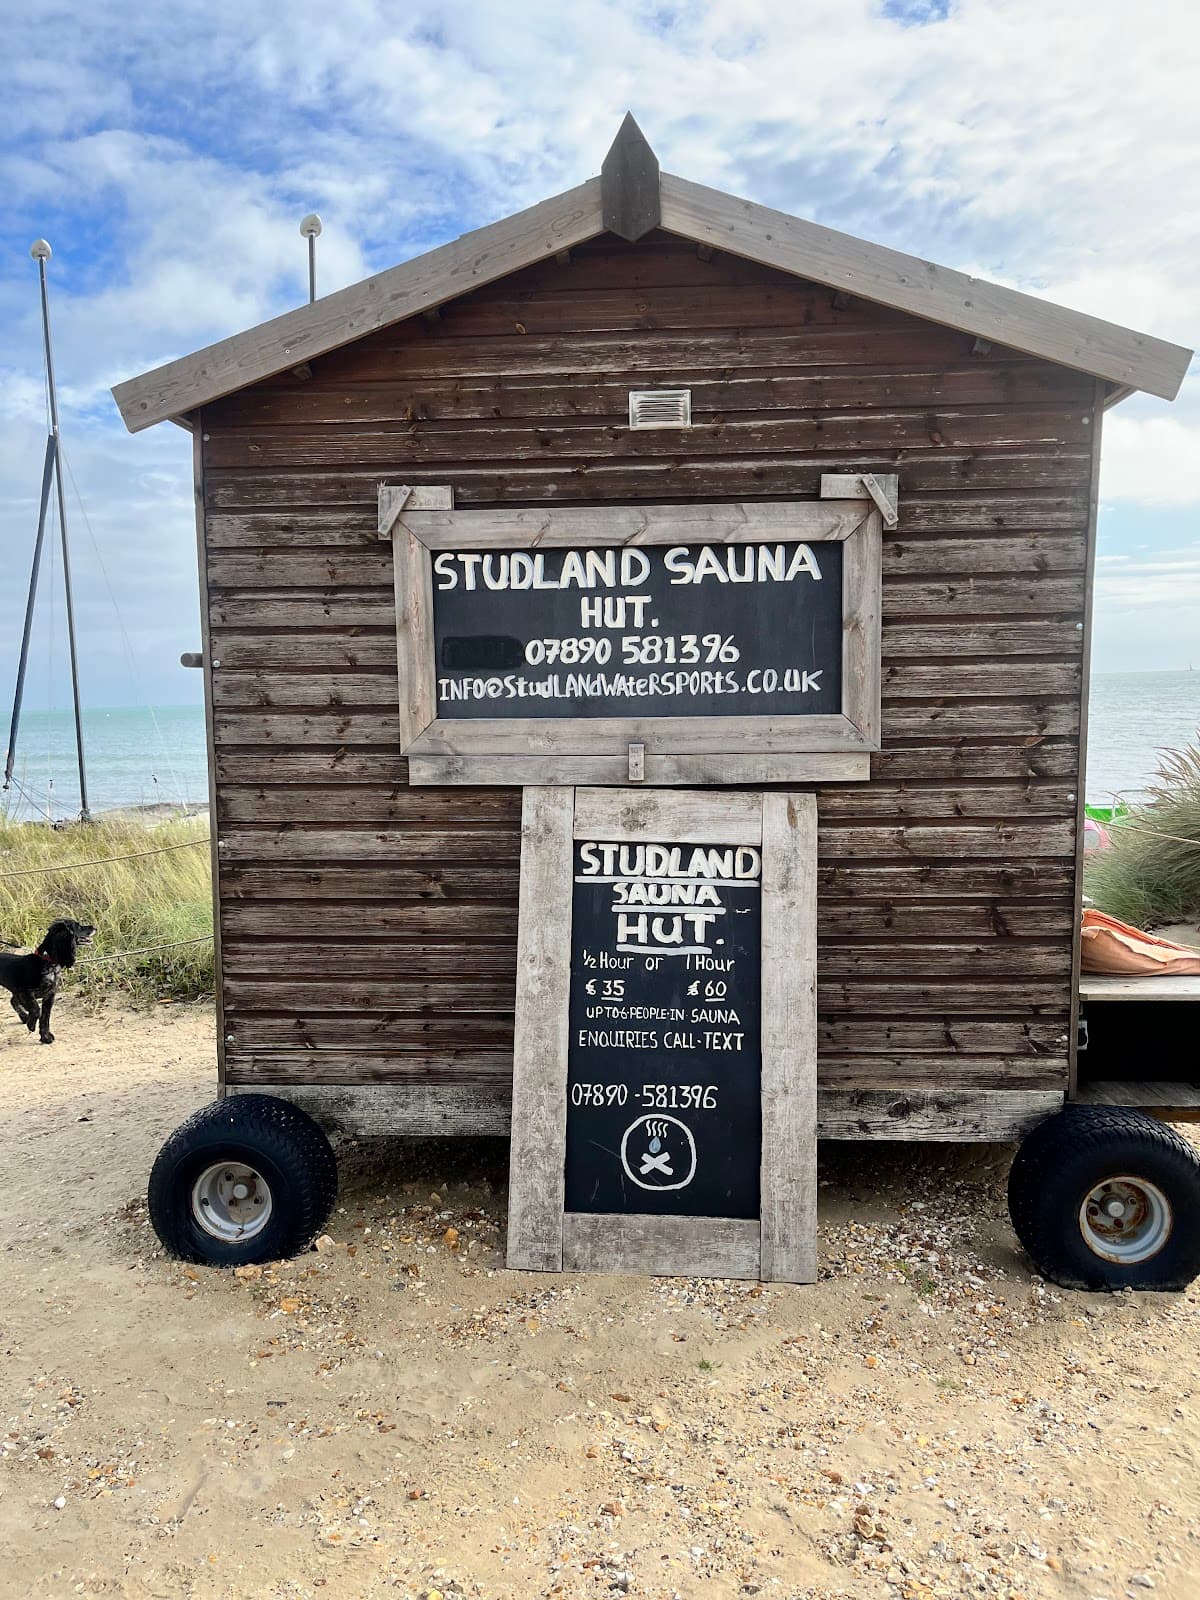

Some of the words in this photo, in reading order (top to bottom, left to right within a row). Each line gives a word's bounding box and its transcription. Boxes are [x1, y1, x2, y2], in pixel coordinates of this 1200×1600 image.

[434, 547, 651, 591] STUDLAND
[664, 543, 823, 585] SAUNA
[580, 595, 660, 628] HUT.
[524, 636, 612, 666] 07890
[621, 633, 741, 665] 581396
[580, 842, 761, 878] STUDLAND
[612, 882, 722, 905] SAUNA
[599, 951, 634, 970] Hour
[644, 956, 664, 971] or
[695, 954, 735, 972] Hour
[690, 1008, 741, 1025] SAUNA
[578, 1029, 658, 1049] ENQUIRIES
[571, 1083, 628, 1107] 07890
